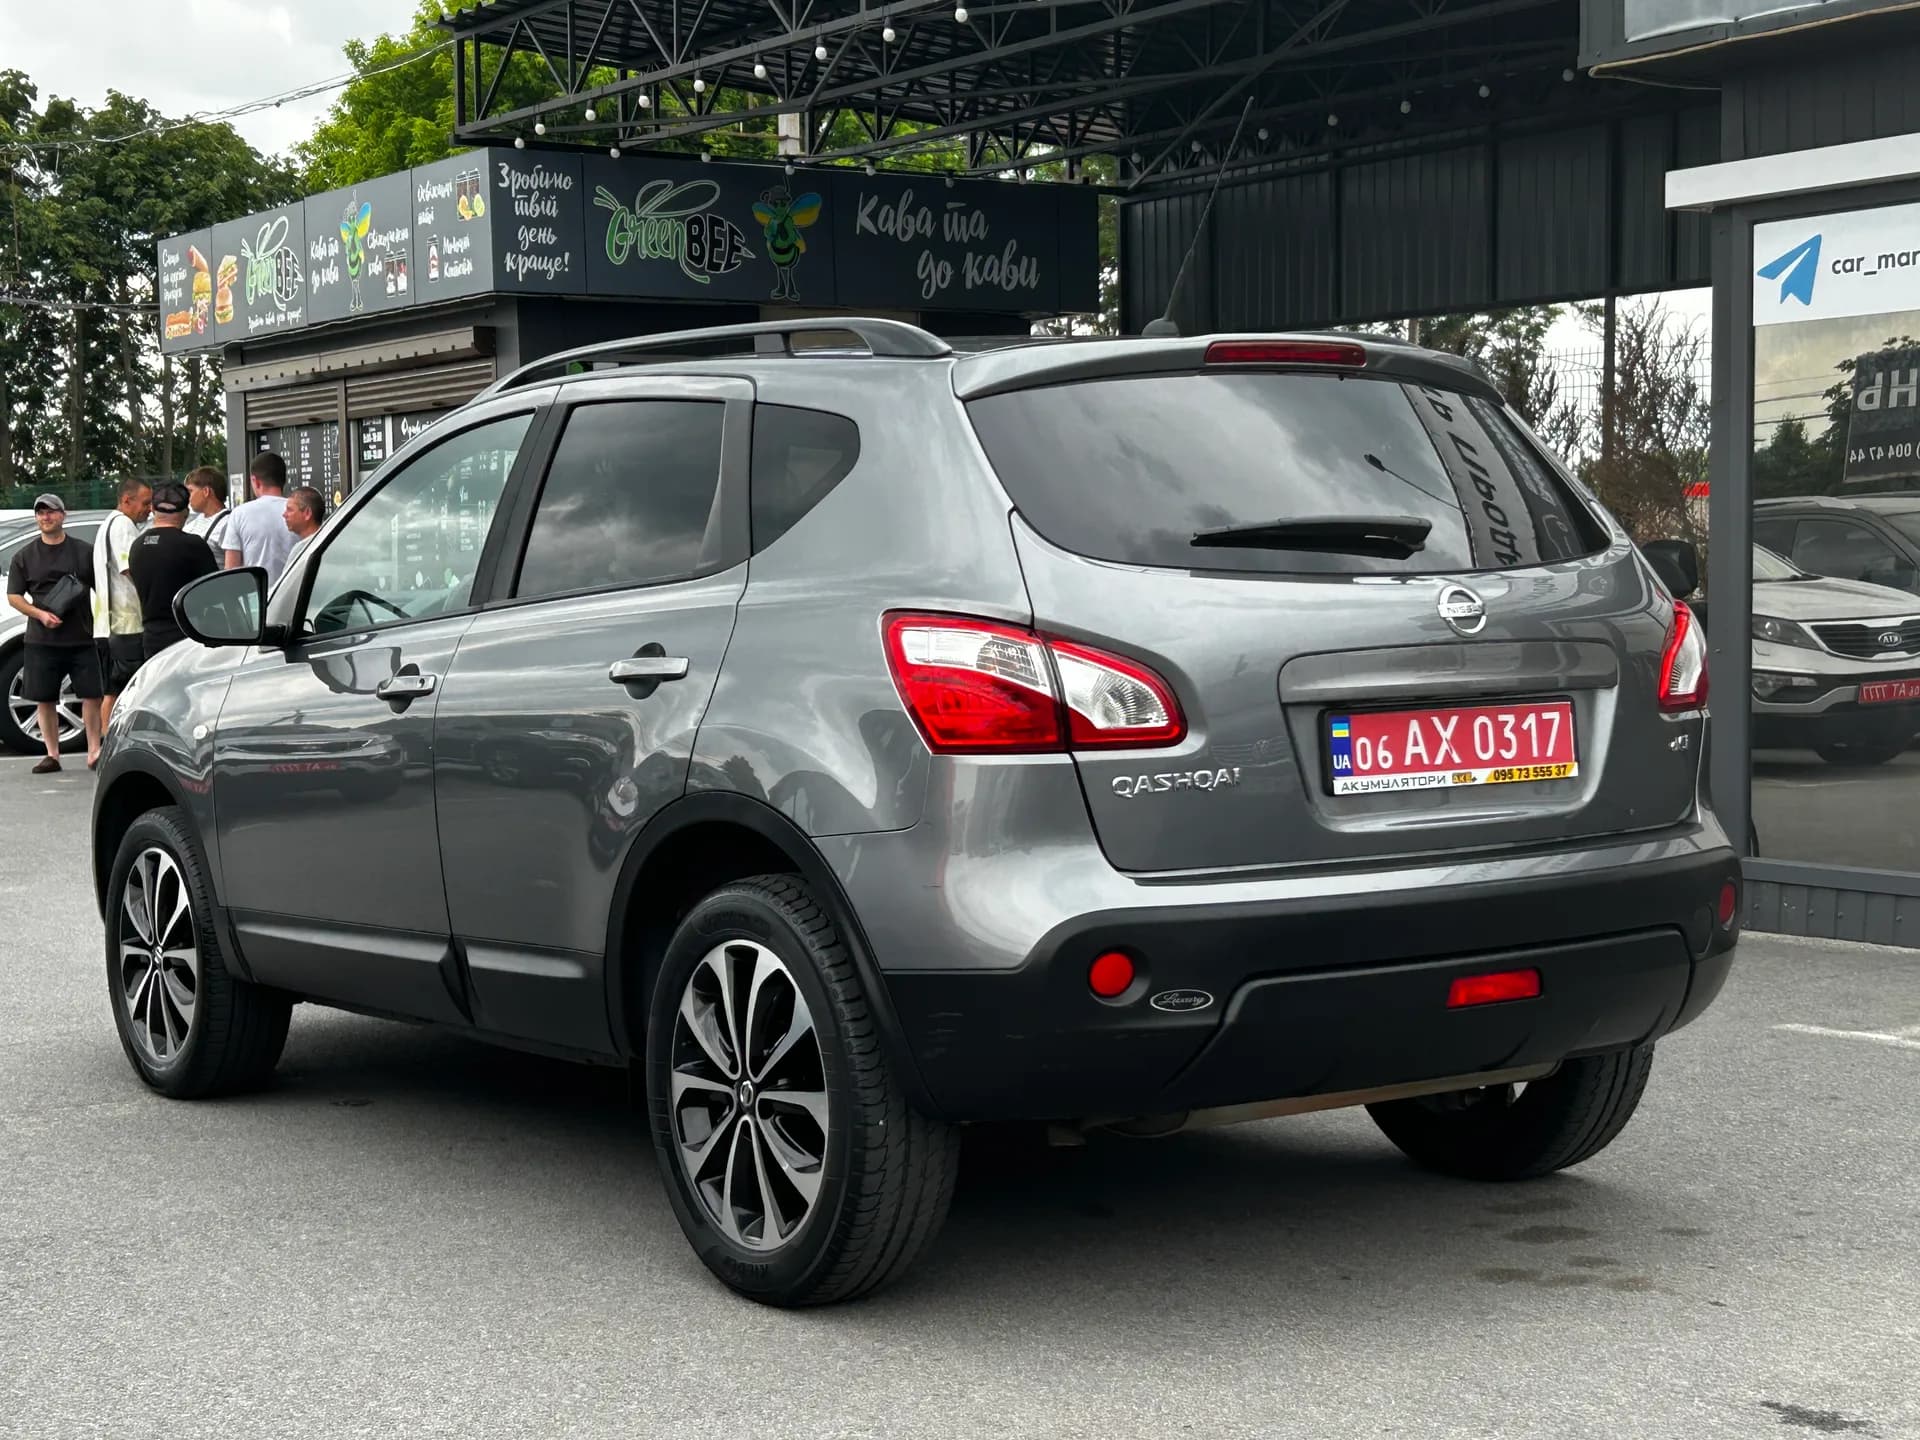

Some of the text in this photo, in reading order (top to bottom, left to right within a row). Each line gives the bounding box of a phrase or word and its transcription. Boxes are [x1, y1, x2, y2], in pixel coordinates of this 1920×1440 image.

[498, 162, 573, 197] Зробимо
[514, 190, 559, 218] твій
[856, 188, 990, 244] Кава та
[517, 225, 558, 251] день
[504, 251, 570, 282] краще!
[916, 239, 1041, 300] до кави
[1355, 711, 1561, 770] 06 AX 0317
[1333, 754, 1351, 770] UA
[1111, 767, 1241, 798] QASHQAI
[1341, 775, 1447, 792] АКУМУЛЯТОРИ
[1493, 768, 1514, 781] 095
[1516, 767, 1530, 779] 73
[1532, 766, 1552, 778] 555
[1554, 764, 1567, 776] 37
